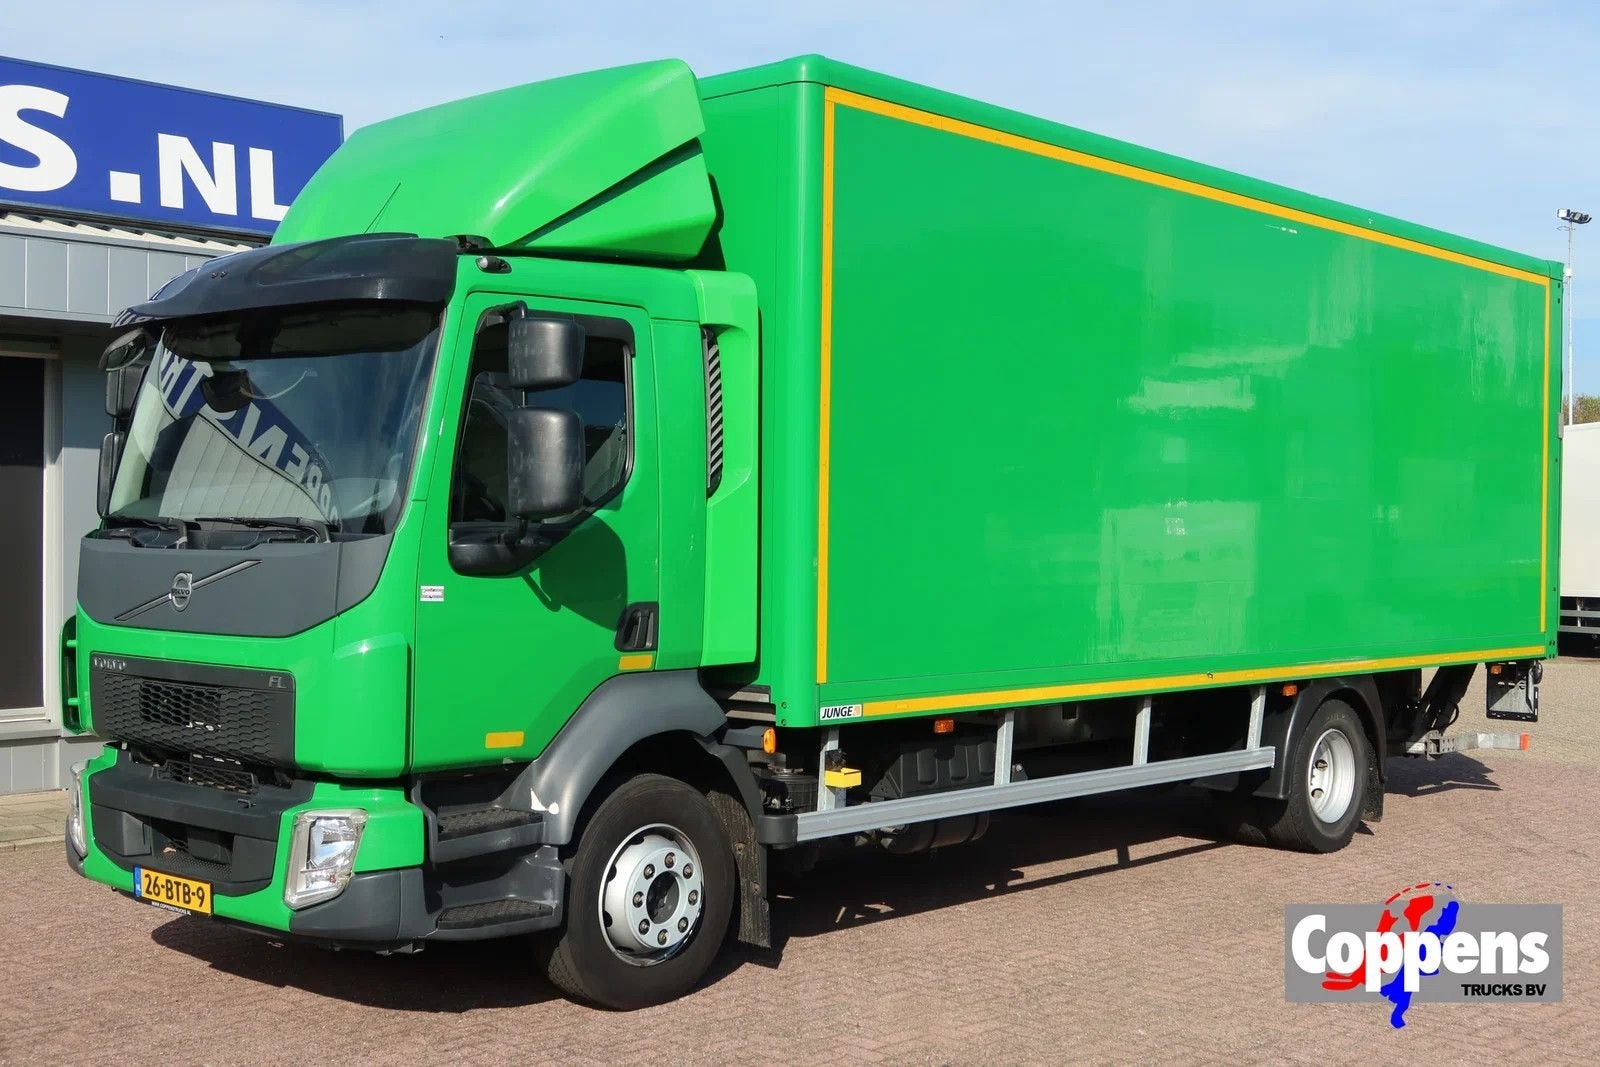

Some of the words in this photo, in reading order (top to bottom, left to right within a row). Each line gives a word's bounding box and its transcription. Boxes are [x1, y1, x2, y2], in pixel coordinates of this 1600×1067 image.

[94, 656, 126, 670] VOLVO
[268, 676, 287, 689] FL
[822, 706, 853, 719] JUNGE
[145, 873, 205, 908] 26-BTB-9
